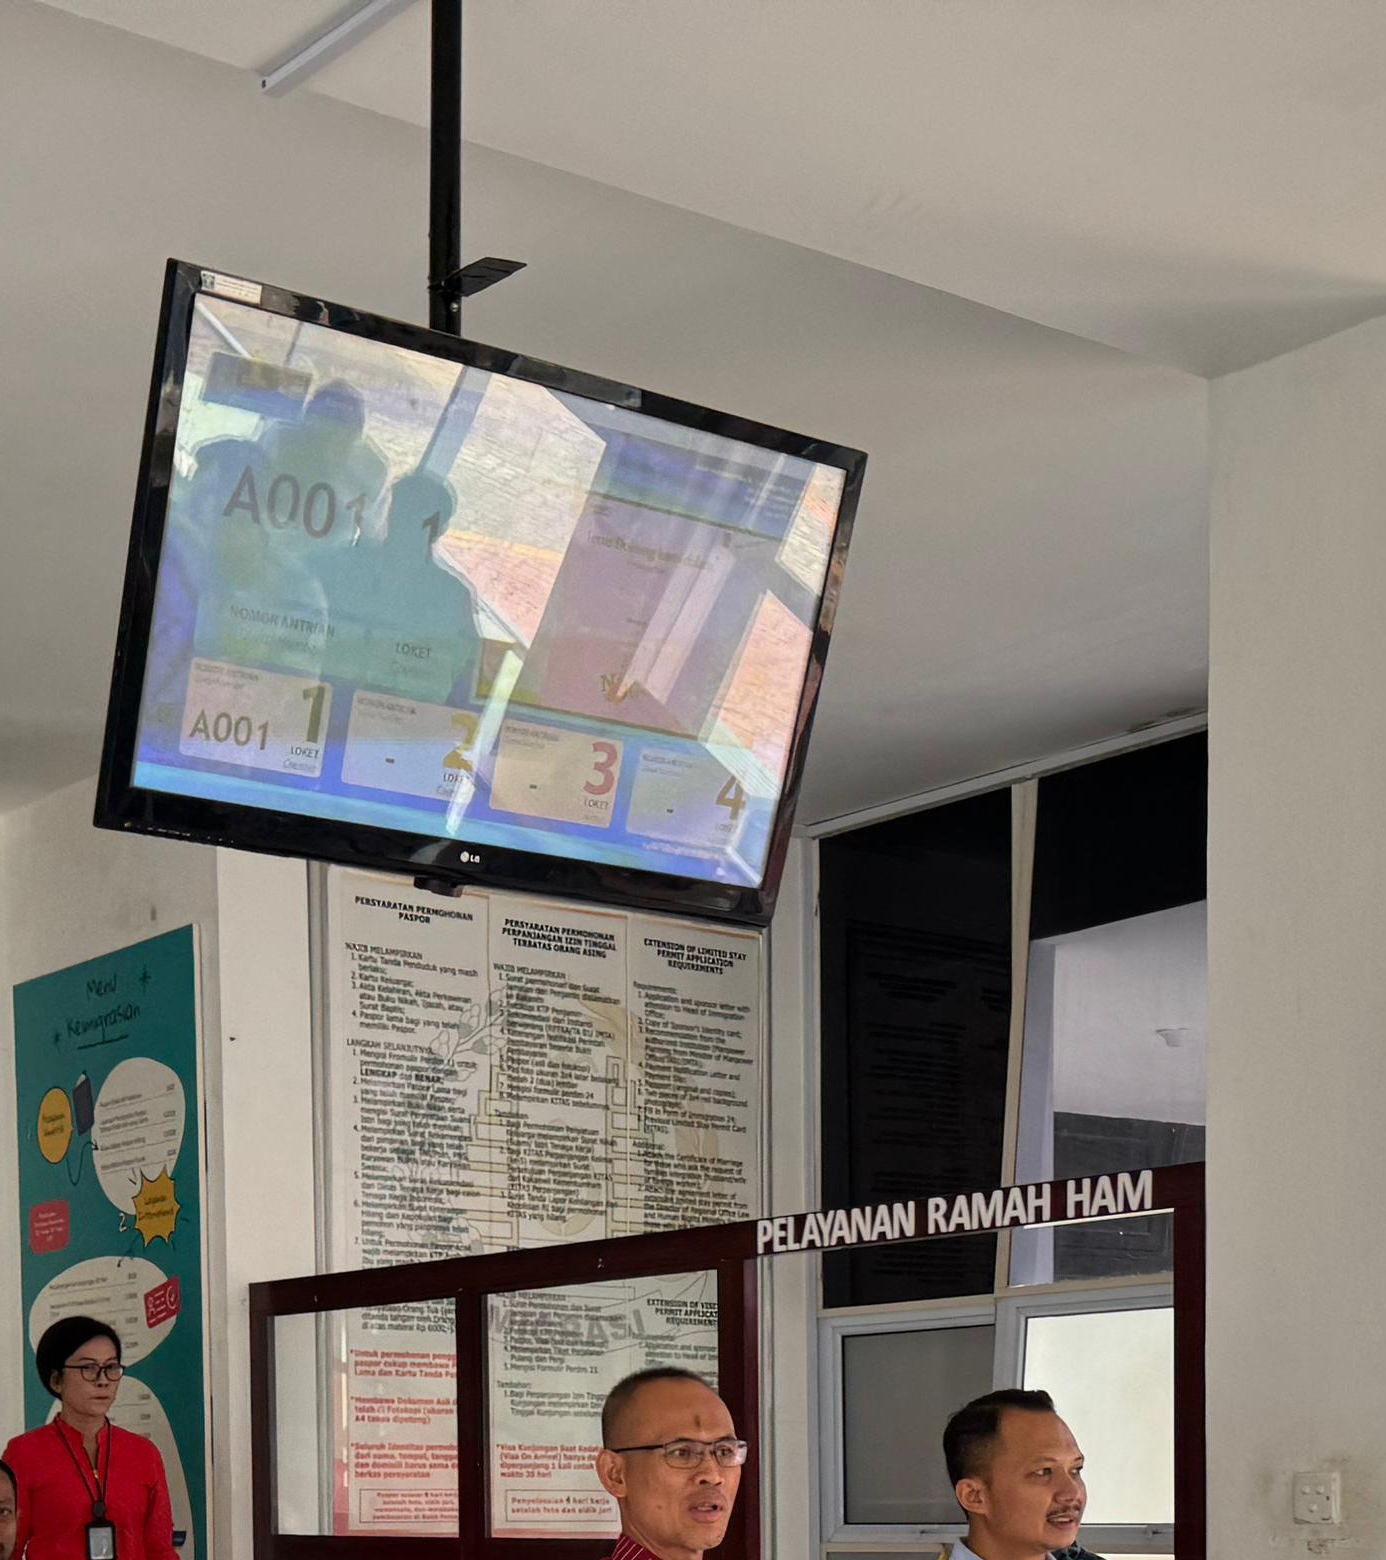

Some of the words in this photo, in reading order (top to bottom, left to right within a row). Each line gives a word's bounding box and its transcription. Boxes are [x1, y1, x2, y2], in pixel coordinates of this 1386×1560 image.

[222, 465, 367, 547] A001
[302, 685, 326, 743] 1
[189, 709, 270, 750] A001
[583, 741, 619, 796] 3
[715, 773, 746, 820] 4
[354, 896, 415, 913] PERSYARATAN
[416, 905, 474, 921] PERMOHONAN
[398, 912, 431, 924] PASPOR
[502, 927, 563, 944] PERPANJANGAN
[584, 939, 616, 951] TINGGAL
[505, 918, 561, 934] PERSYARATAN
[561, 927, 615, 941] PERMOHONAN
[513, 938, 552, 951] TERBATAS
[553, 944, 581, 956] ORANG
[582, 947, 607, 958] ASING
[644, 938, 685, 951] EXTENSION
[697, 946, 728, 958] LIMITED
[729, 951, 747, 961] STAY
[657, 949, 685, 959] PERMIT
[686, 953, 734, 967] APPLICATION
[668, 960, 724, 975] REQUIREMENTS
[756, 1201, 915, 1254] PELAYANAN
[928, 1183, 1051, 1235] RAMAH
[1066, 1169, 1154, 1218] HAM
